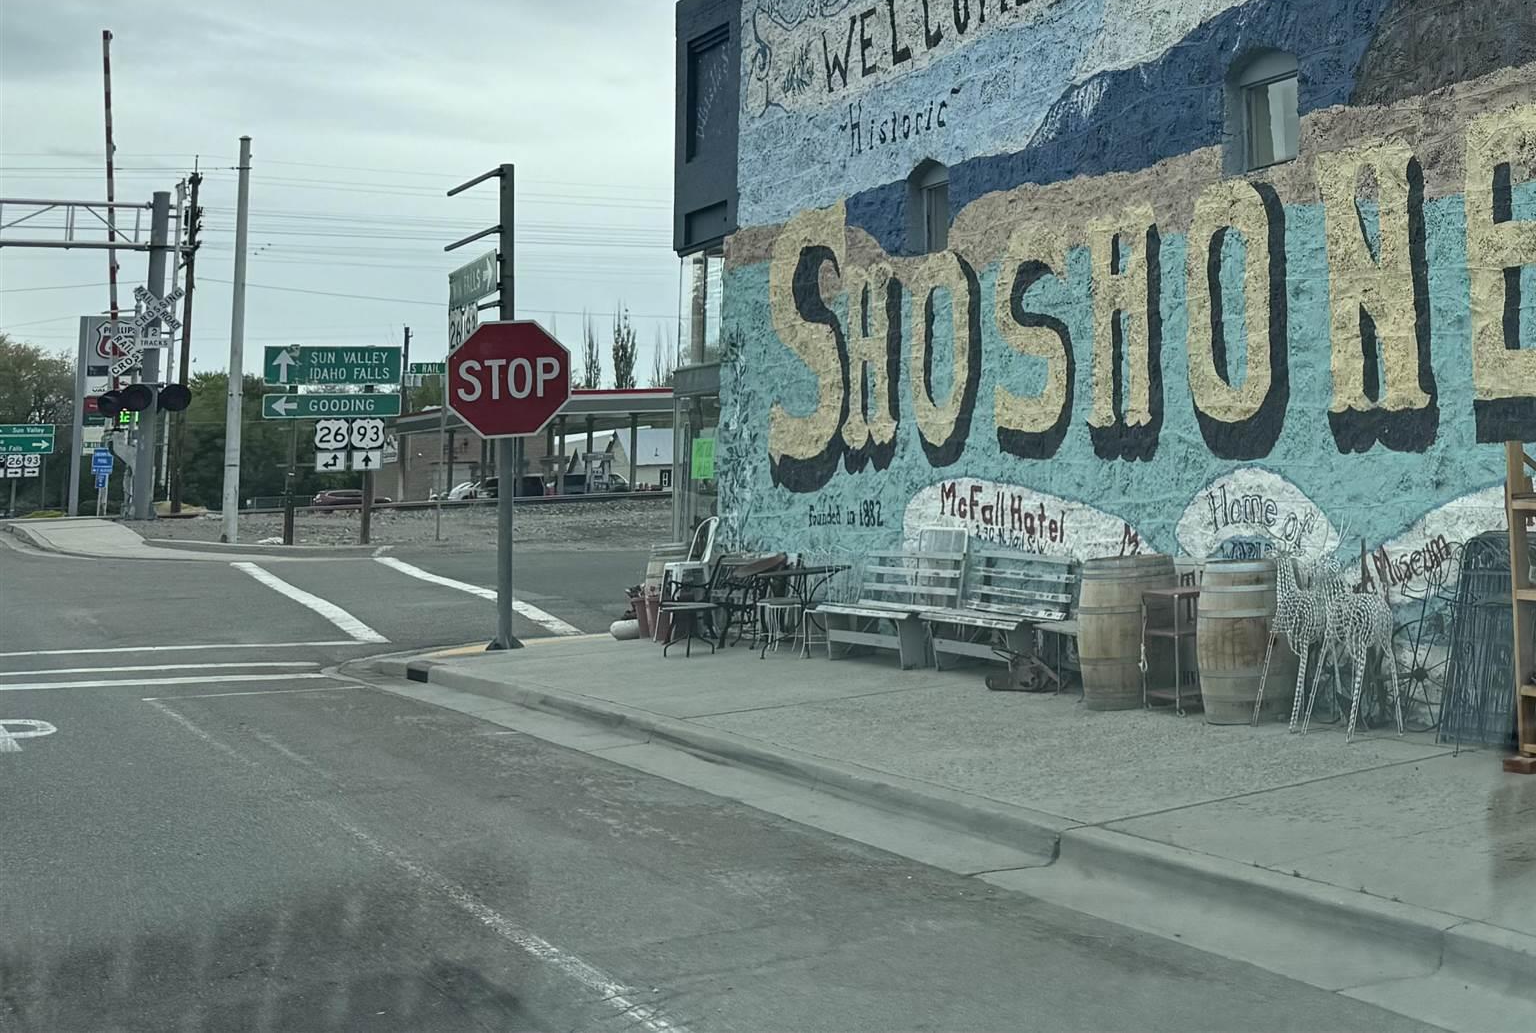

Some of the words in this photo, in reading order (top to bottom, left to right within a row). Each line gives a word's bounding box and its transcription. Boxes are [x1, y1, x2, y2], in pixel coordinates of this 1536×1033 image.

[135, 287, 154, 305] RAIL
[160, 311, 181, 330] ROAD
[151, 328, 158, 337] 2
[450, 320, 462, 350] 26
[113, 335, 134, 355] RAIL
[310, 352, 335, 364] SUN
[343, 352, 389, 364] VALLEY
[309, 367, 347, 380] IDAHO
[353, 367, 390, 379] FALLS
[411, 364, 417, 373] S
[422, 364, 440, 373] RAIL
[457, 357, 560, 402] STOP
[309, 399, 375, 412] GOODING
[319, 426, 346, 444] 26
[357, 425, 380, 443] 93
[9, 457, 22, 465] 26
[26, 456, 39, 465] 93
[860, 499, 884, 527] 1882
[940, 482, 1005, 527] McFall
[1207, 483, 1278, 534] Home
